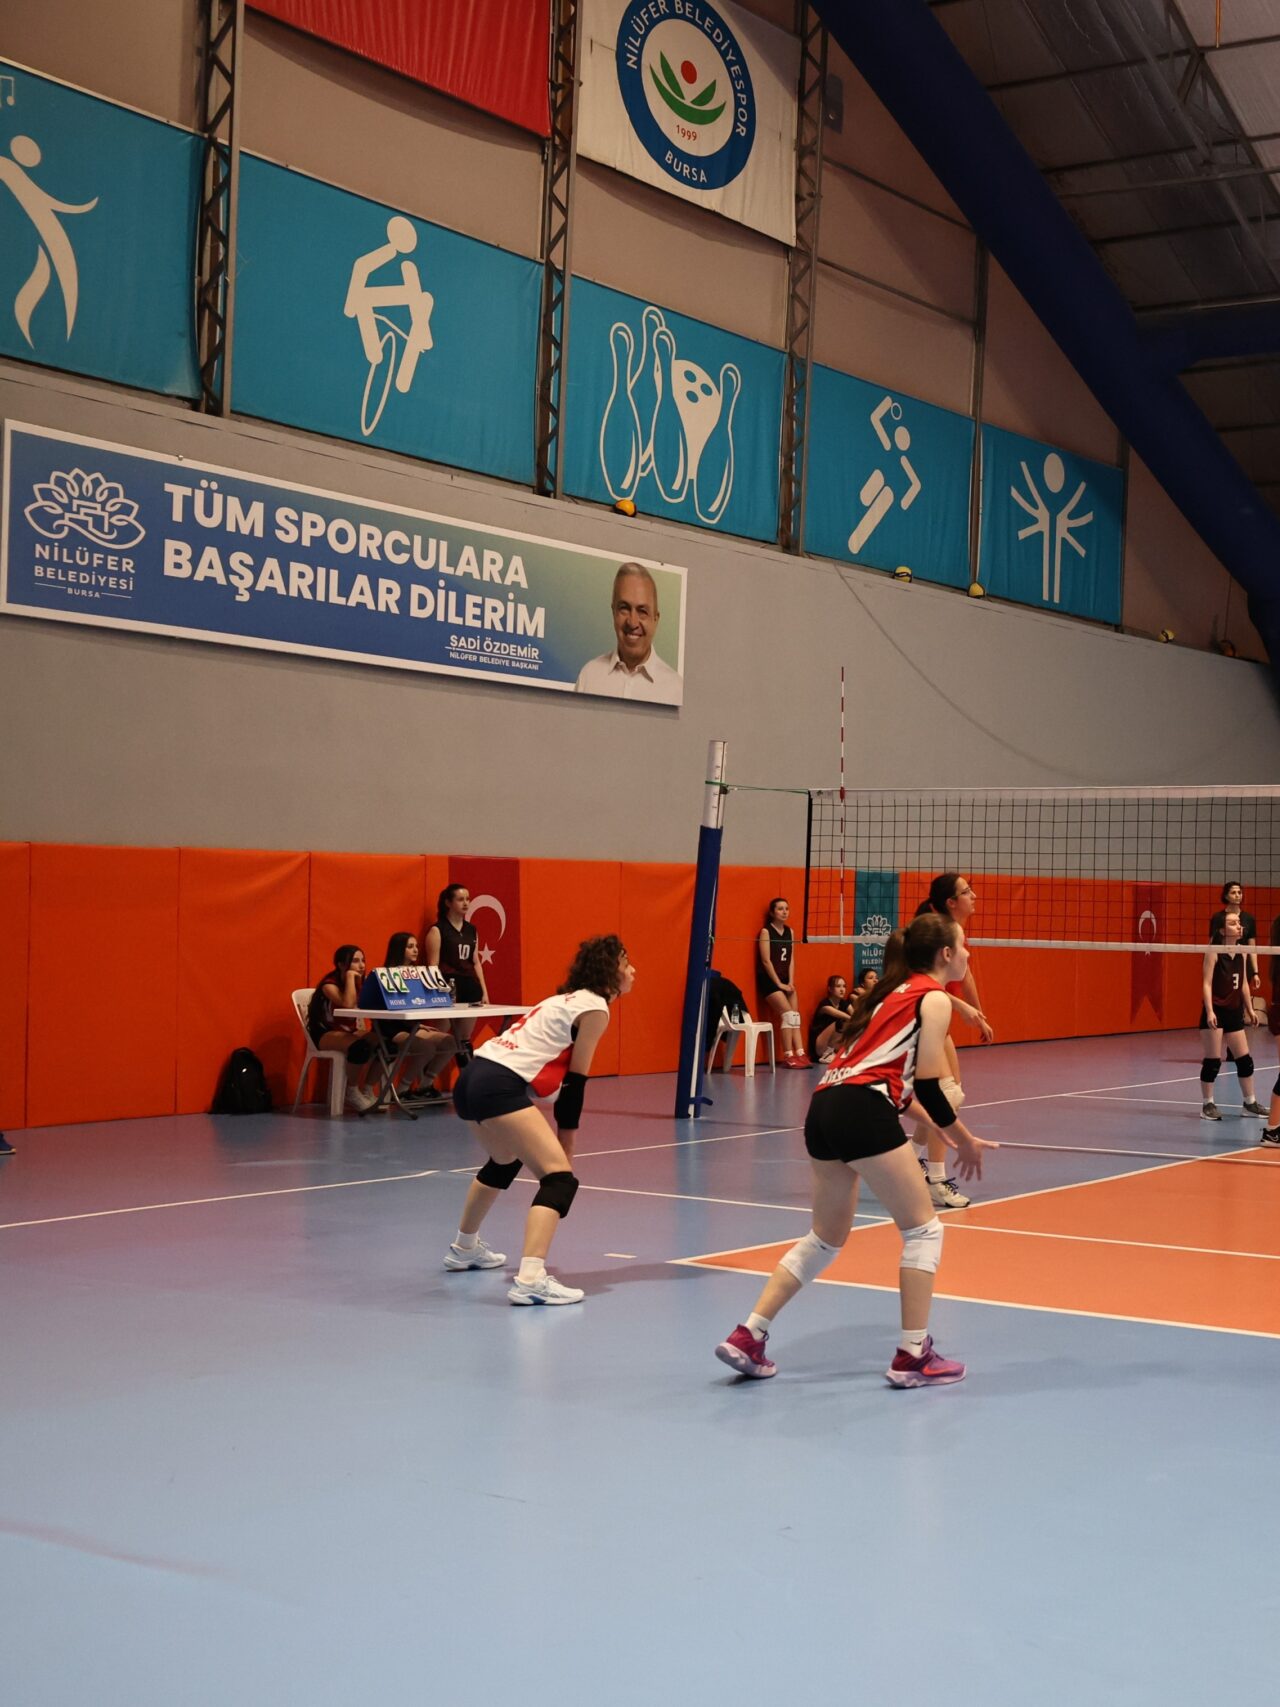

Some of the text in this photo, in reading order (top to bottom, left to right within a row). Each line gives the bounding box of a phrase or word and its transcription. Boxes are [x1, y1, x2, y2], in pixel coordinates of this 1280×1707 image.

[626, 0, 748, 137] NİLÜFER BELEDİYESPOR
[675, 124, 698, 142] 1999
[664, 150, 708, 184] BURSA
[163, 479, 529, 589] TÜM SPORCULARA
[34, 542, 136, 574] NİLÜFER
[34, 565, 134, 591] BELEDİYESİ
[163, 538, 546, 639] BAŞARILAR DİLERİM
[67, 587, 101, 599] BURSA
[449, 651, 478, 662] NİLÜFER
[483, 637, 540, 660] ÖZDEMİR
[458, 943, 470, 960] 10
[780, 947, 788, 962] 2
[1232, 972, 1240, 990] 3
